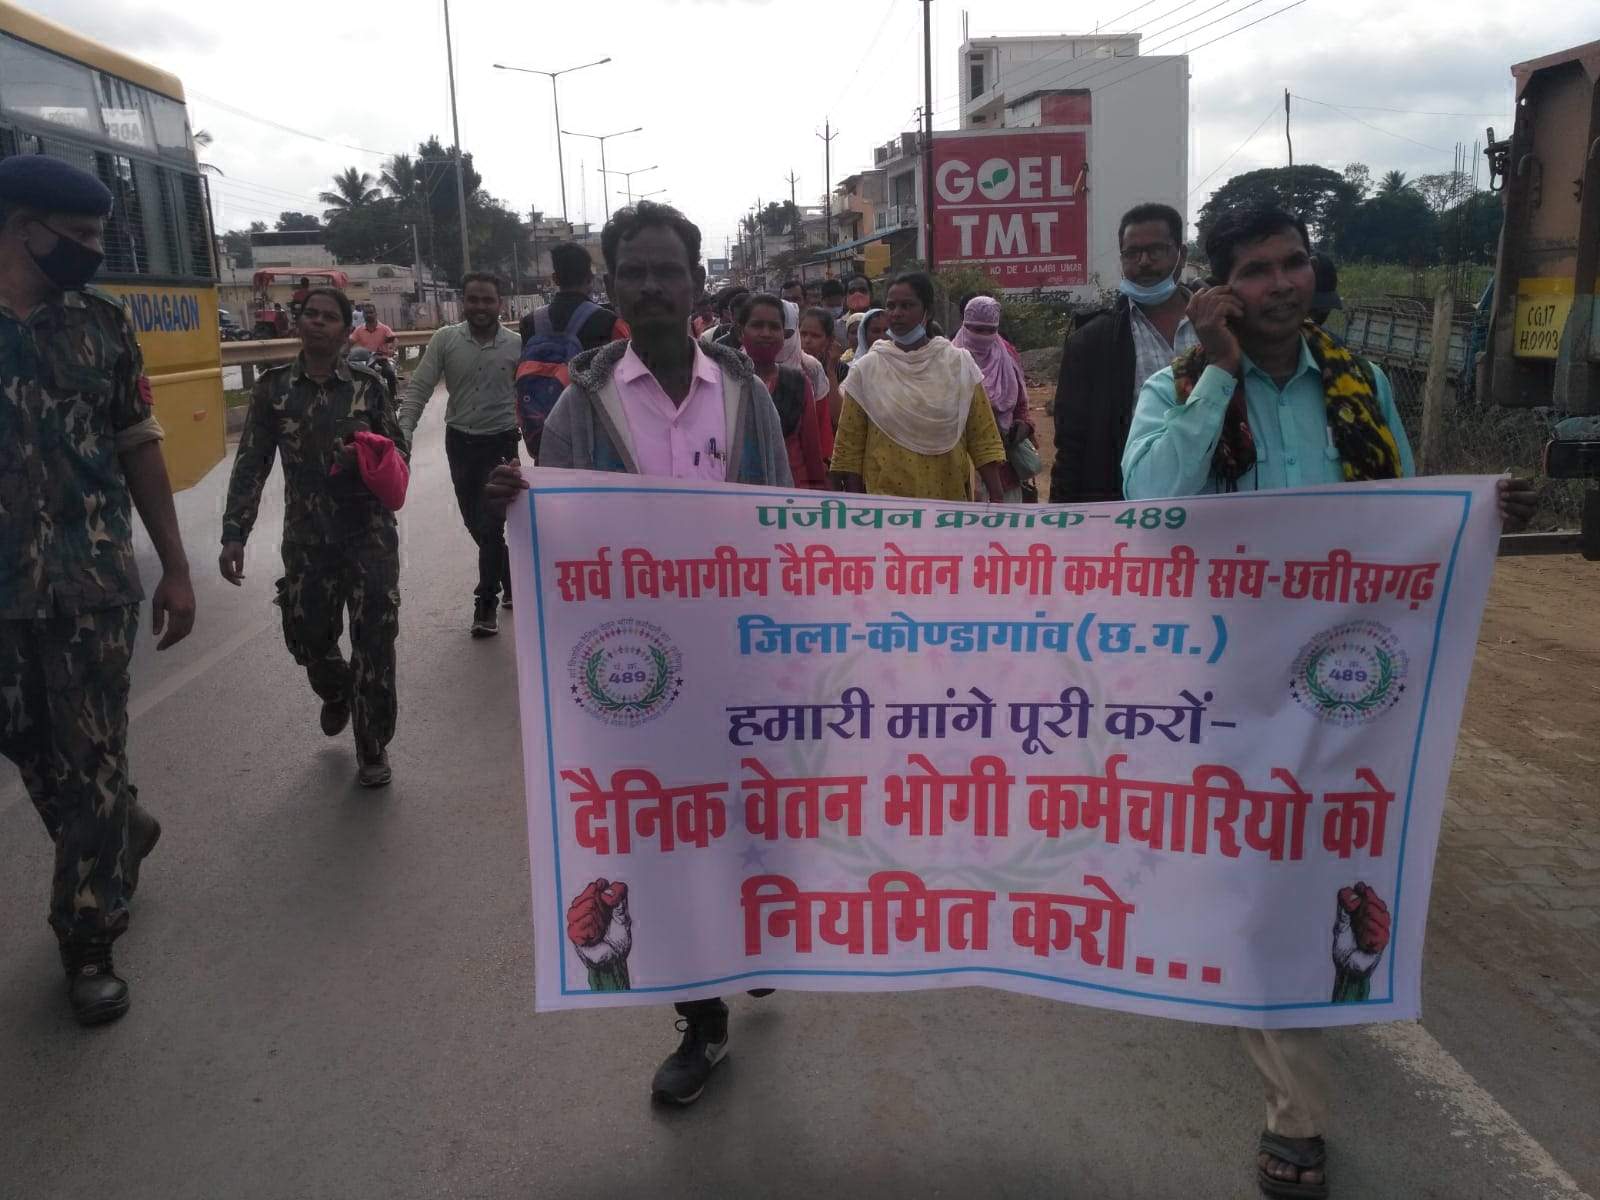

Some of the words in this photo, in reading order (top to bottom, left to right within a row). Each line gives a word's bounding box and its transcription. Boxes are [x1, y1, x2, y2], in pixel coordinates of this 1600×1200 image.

[936, 156, 1074, 202] GOEL
[953, 212, 1058, 257] TMT
[1006, 265, 1018, 274] DE
[121, 293, 200, 332] NDAGAON
[756, 498, 926, 529] पंजीयन
[556, 547, 612, 601] सर्व
[622, 546, 771, 599] विभागीय
[775, 543, 876, 596] दैनिक
[884, 542, 964, 595] वेतन
[973, 542, 1057, 596] भोगी
[1063, 542, 1199, 597] कर्मचारी
[609, 671, 647, 683] 489
[1328, 669, 1368, 682] 489
[726, 687, 875, 746] हमारी
[885, 687, 997, 739] मांगे
[1008, 686, 1095, 755] पूरी
[560, 768, 728, 855] दैनिक
[741, 758, 868, 841] वेतन
[884, 753, 1016, 837] भोगी
[1026, 754, 1313, 860] कर्मचारियो
[1322, 768, 1396, 859] को
[741, 871, 997, 956] नियमित
